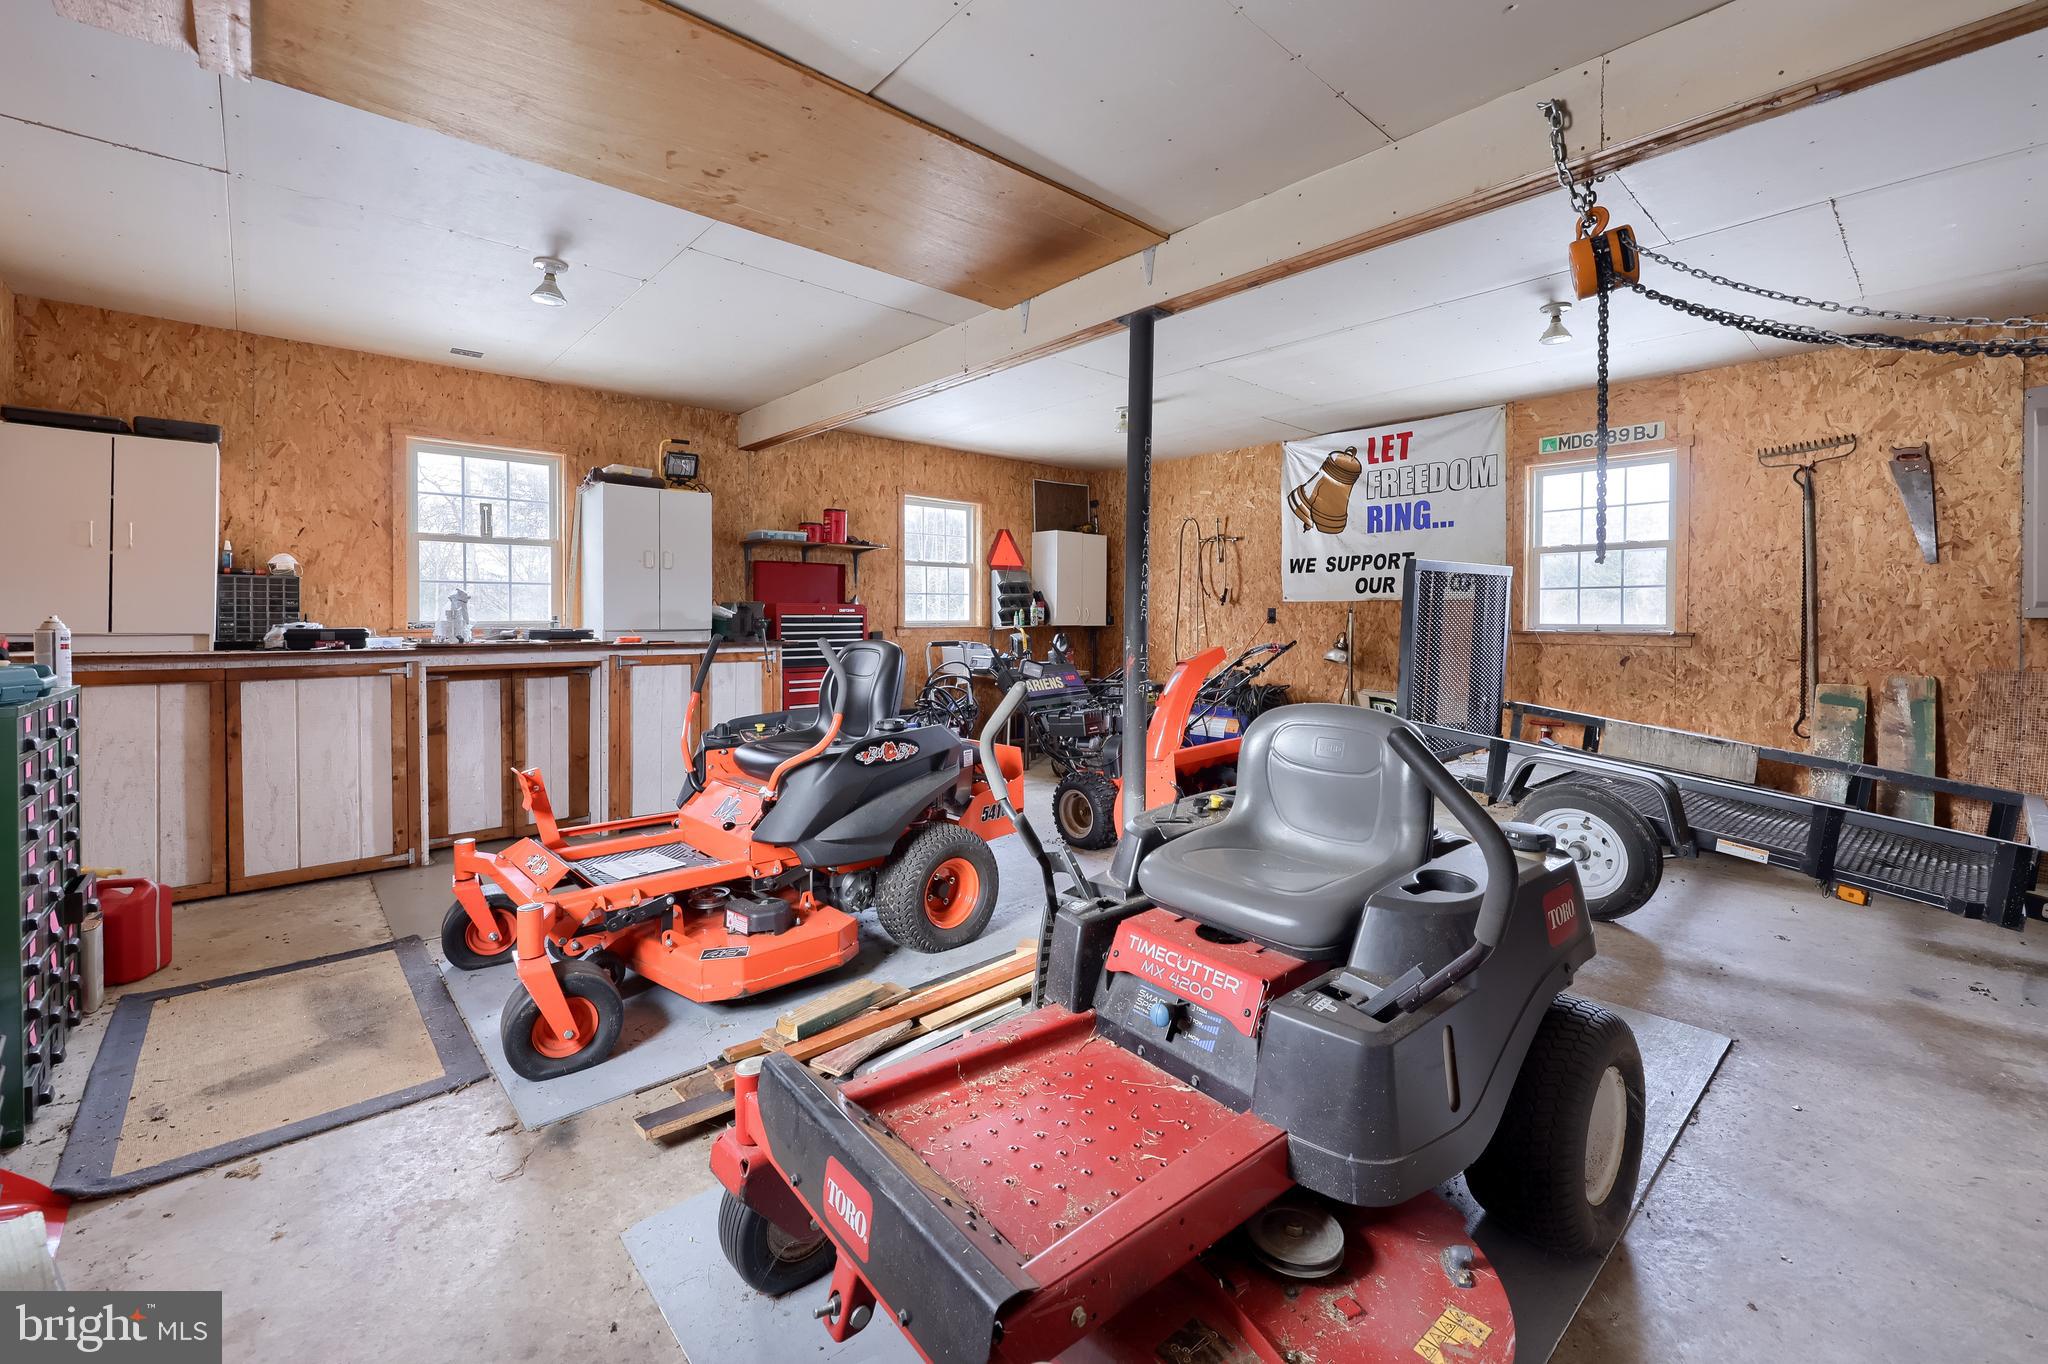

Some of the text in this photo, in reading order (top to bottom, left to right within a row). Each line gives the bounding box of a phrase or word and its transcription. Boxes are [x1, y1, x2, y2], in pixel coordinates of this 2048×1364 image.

[1367, 431, 1413, 465] LET
[1366, 454, 1498, 500] FREEDOM
[1366, 500, 1455, 534] RING...
[1290, 557, 1317, 574] WE
[1355, 576, 1396, 594] OUR
[1025, 676, 1066, 692] ARIENS
[1547, 899, 1576, 930] TORO
[1129, 934, 1242, 994] TIMECUTTER
[1141, 960, 1214, 1001] MX 4200
[827, 1177, 868, 1238] TORO
